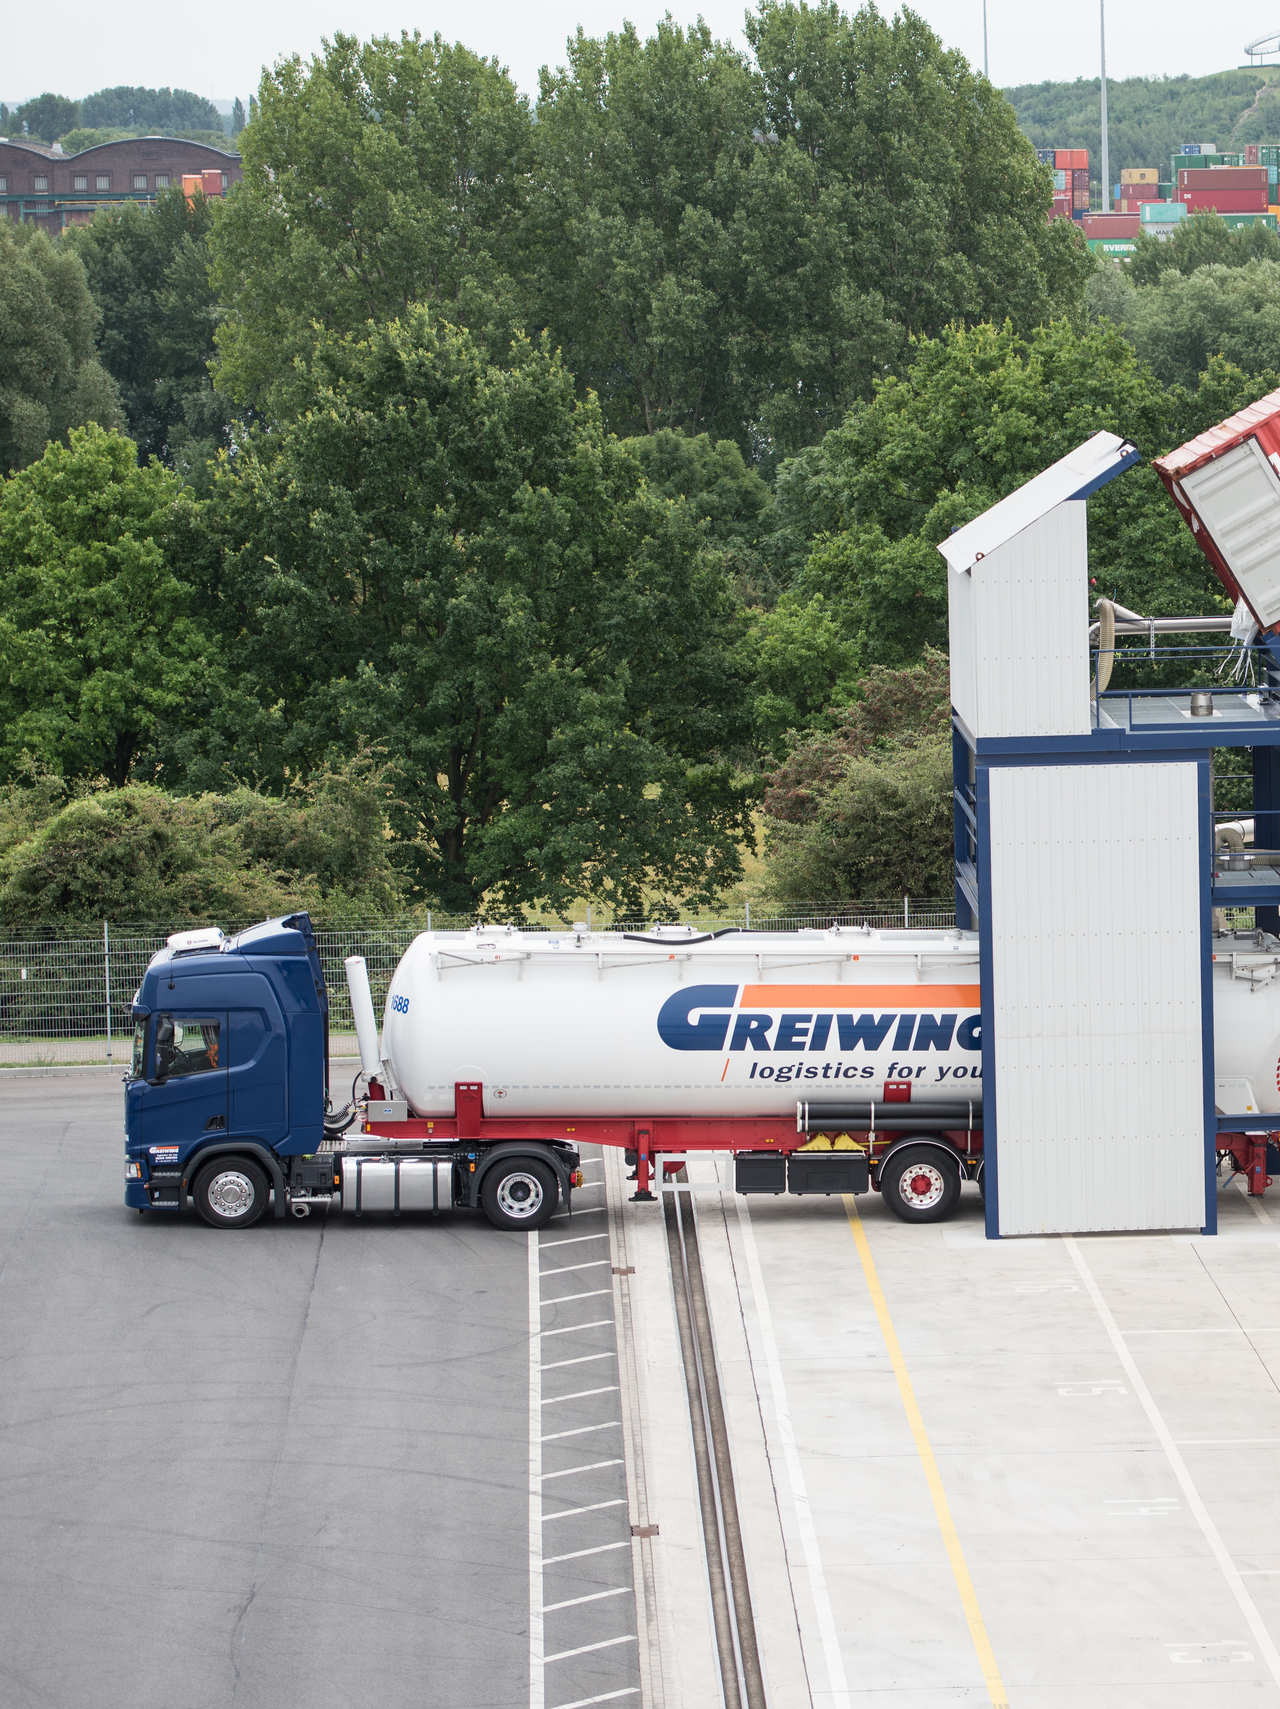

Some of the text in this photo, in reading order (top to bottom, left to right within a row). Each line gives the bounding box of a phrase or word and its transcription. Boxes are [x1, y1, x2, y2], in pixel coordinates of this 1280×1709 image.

[391, 994, 410, 1014] 1688
[657, 985, 983, 1051] GREIWING
[749, 1062, 983, 1082] logistics for you
[1054, 1379, 1128, 1396] 15
[1103, 1497, 1181, 1516] 14
[1164, 1640, 1255, 1663] 13
